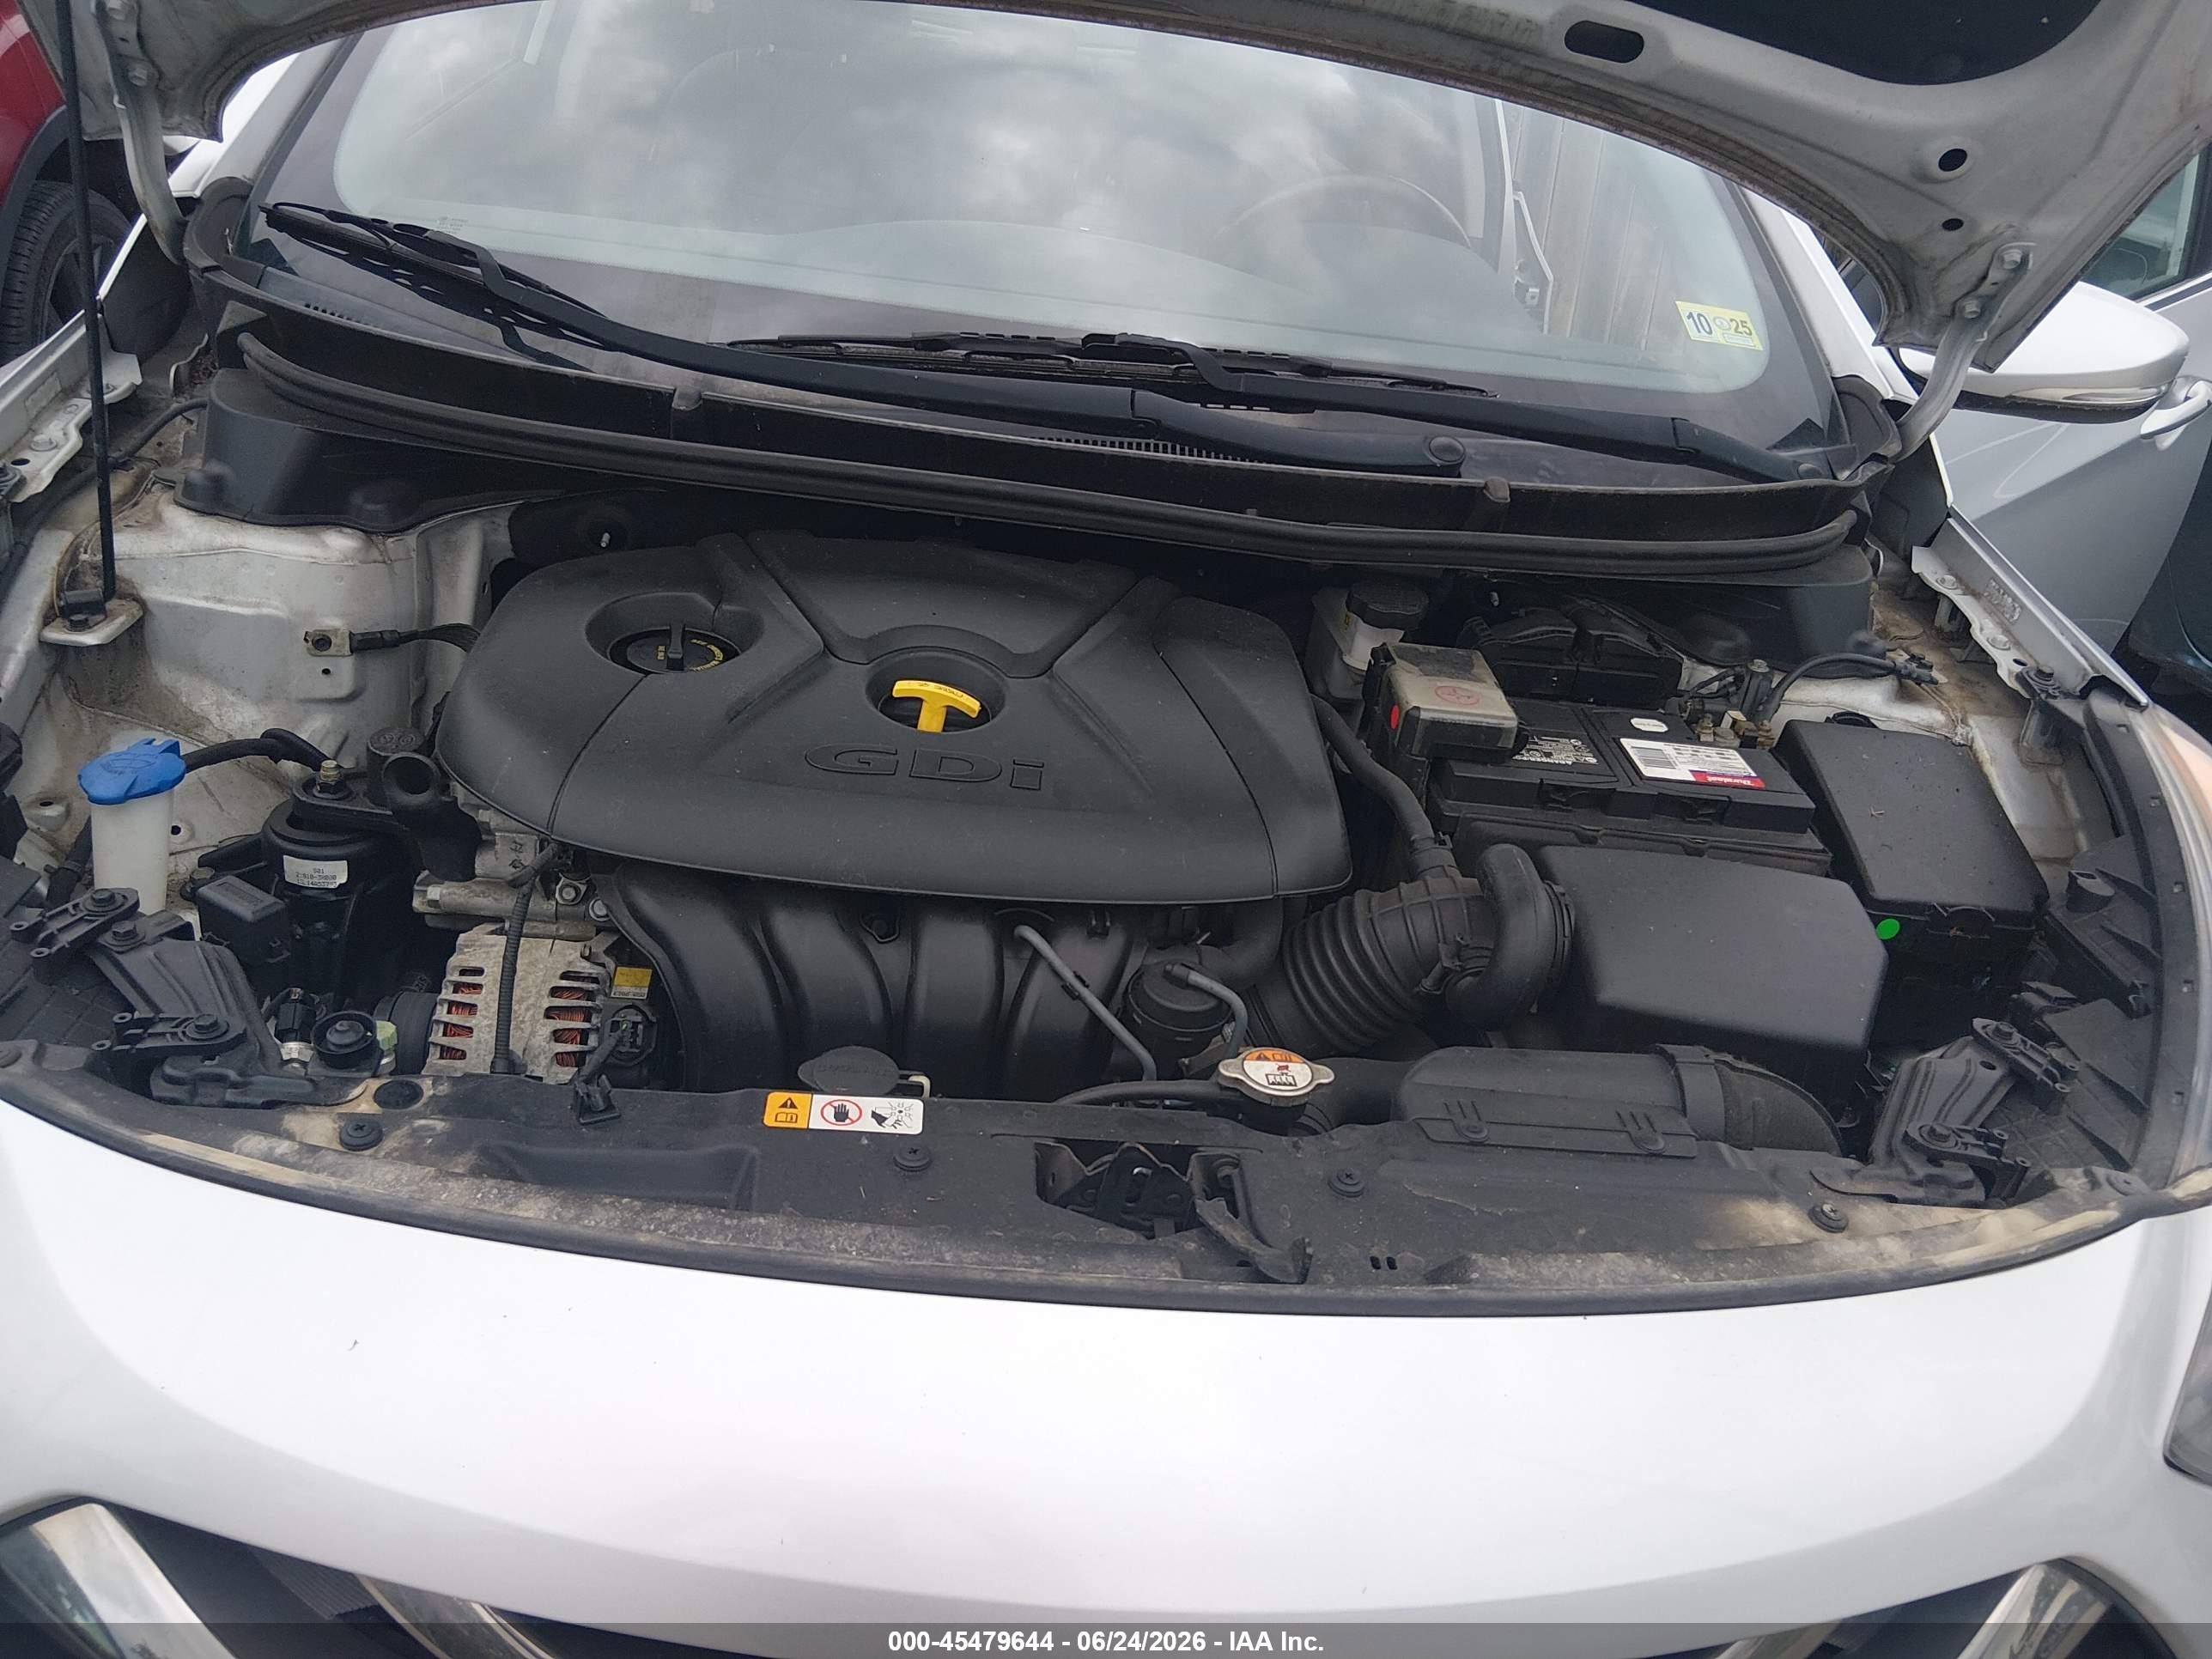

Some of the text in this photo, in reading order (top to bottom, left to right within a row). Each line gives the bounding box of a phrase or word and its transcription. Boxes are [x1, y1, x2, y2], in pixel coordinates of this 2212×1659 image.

[1686, 311, 1753, 337] 10 25
[804, 742, 1045, 791] GDi
[1705, 775, 1755, 787] Duralast
